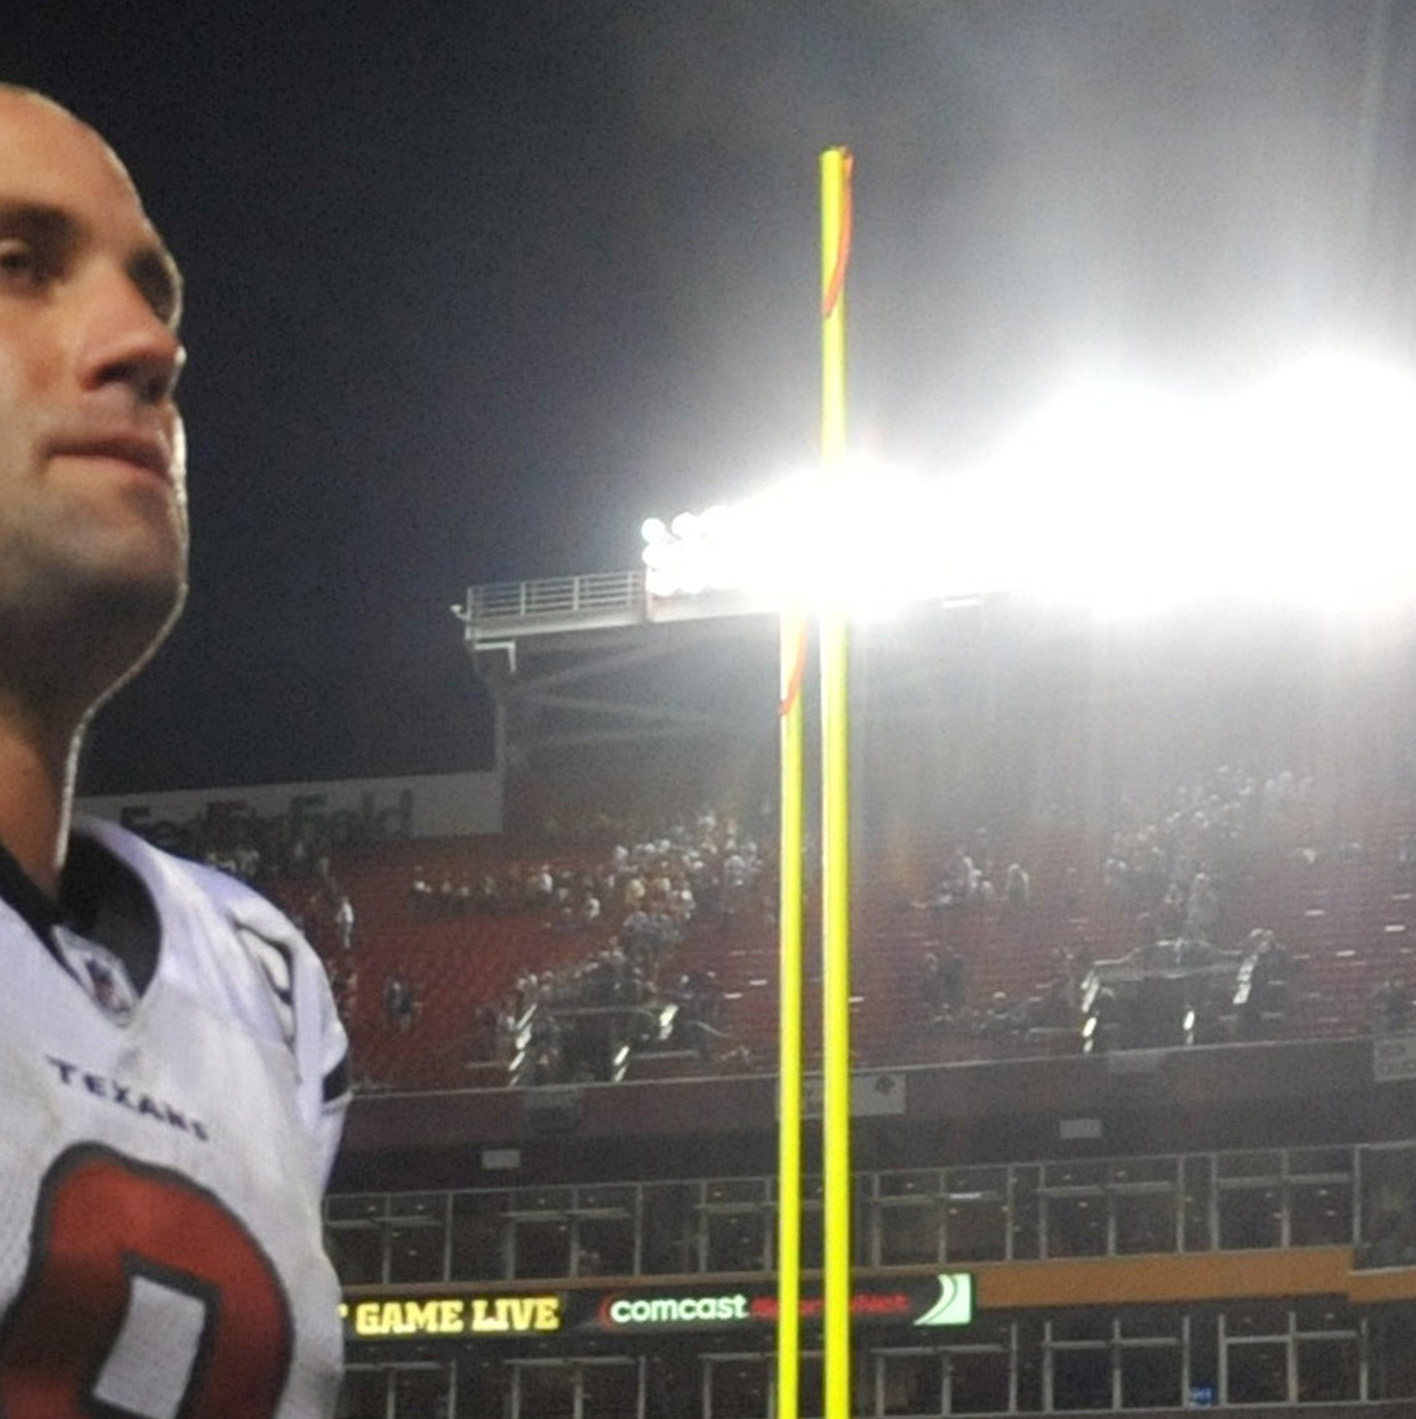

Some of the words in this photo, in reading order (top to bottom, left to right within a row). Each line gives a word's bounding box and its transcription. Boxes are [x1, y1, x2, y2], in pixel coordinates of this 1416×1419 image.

[44, 1055, 209, 1140] TEXANS
[355, 1302, 464, 1334] GAME
[472, 1298, 559, 1331] LIVE
[609, 1294, 749, 1323] comcast
